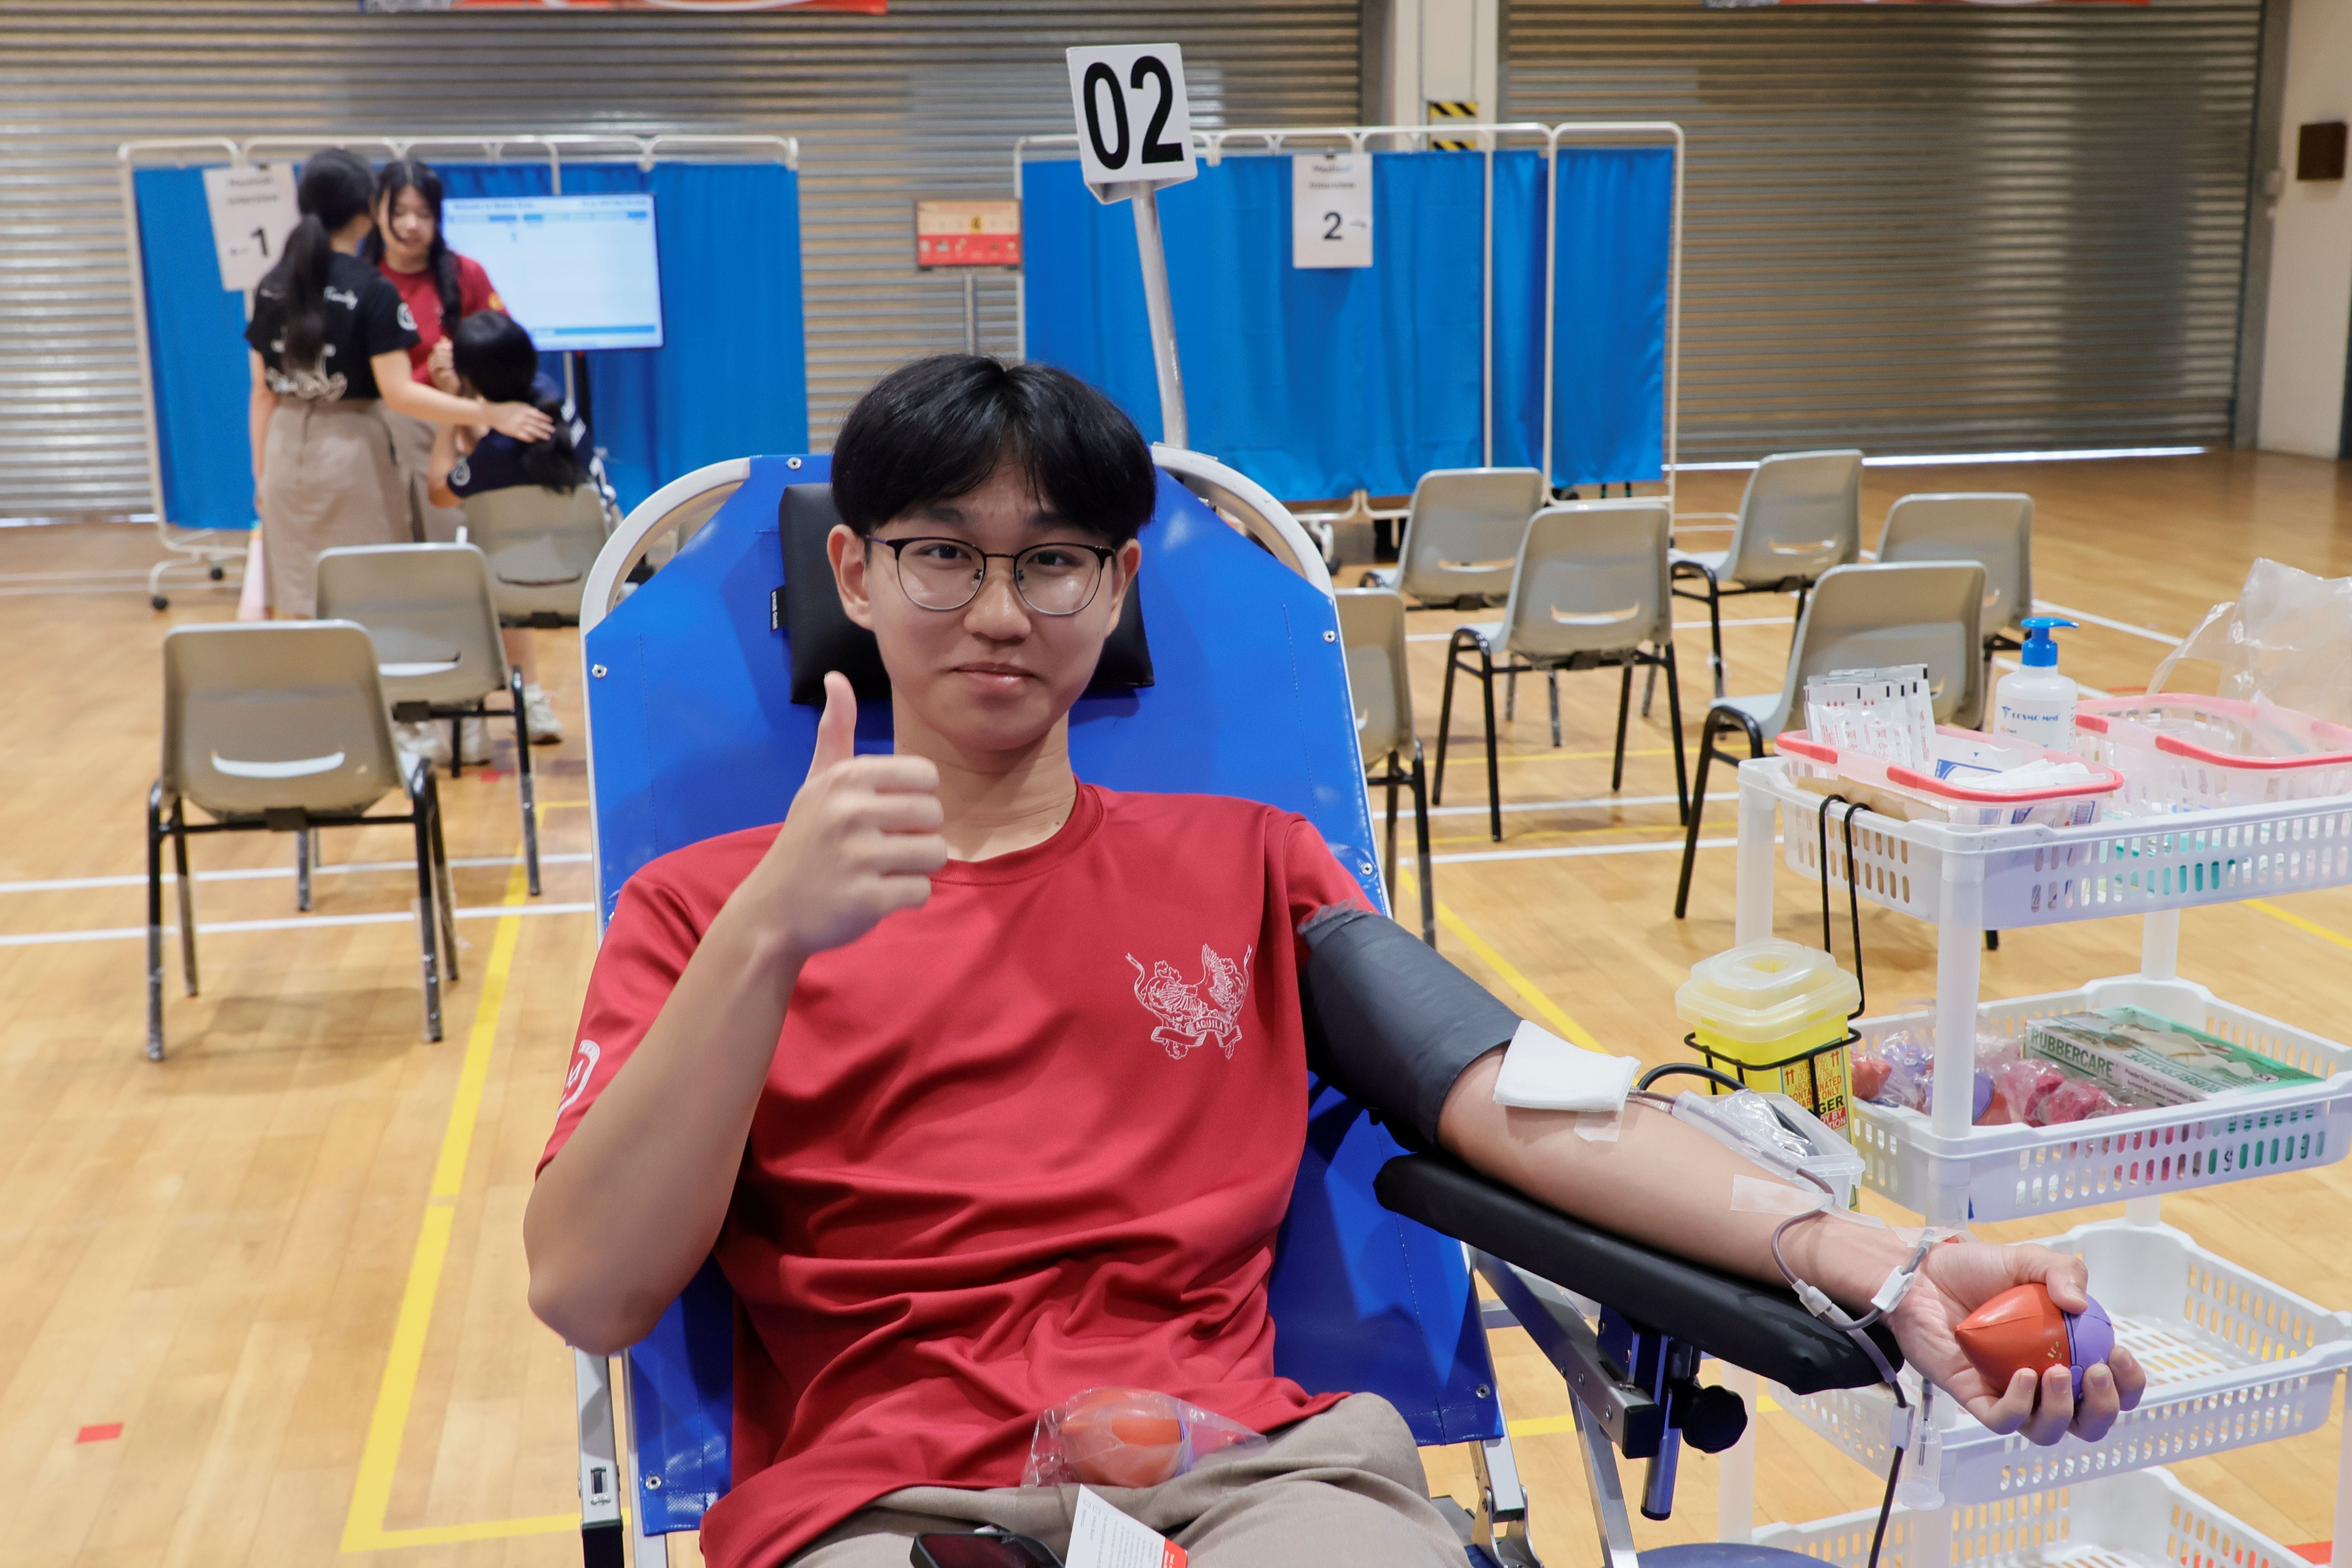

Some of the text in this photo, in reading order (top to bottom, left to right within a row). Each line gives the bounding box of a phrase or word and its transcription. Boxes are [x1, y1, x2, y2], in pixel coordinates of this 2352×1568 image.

[1083, 55, 1184, 170] 02
[1323, 212, 1343, 240] 2
[250, 227, 268, 256] 1
[1196, 1019, 1223, 1031] AQUILA
[2031, 1027, 2114, 1078] RUBBERCARE
[1822, 1085, 1839, 1100] ONLY
[1832, 1108, 1842, 1120] BY
